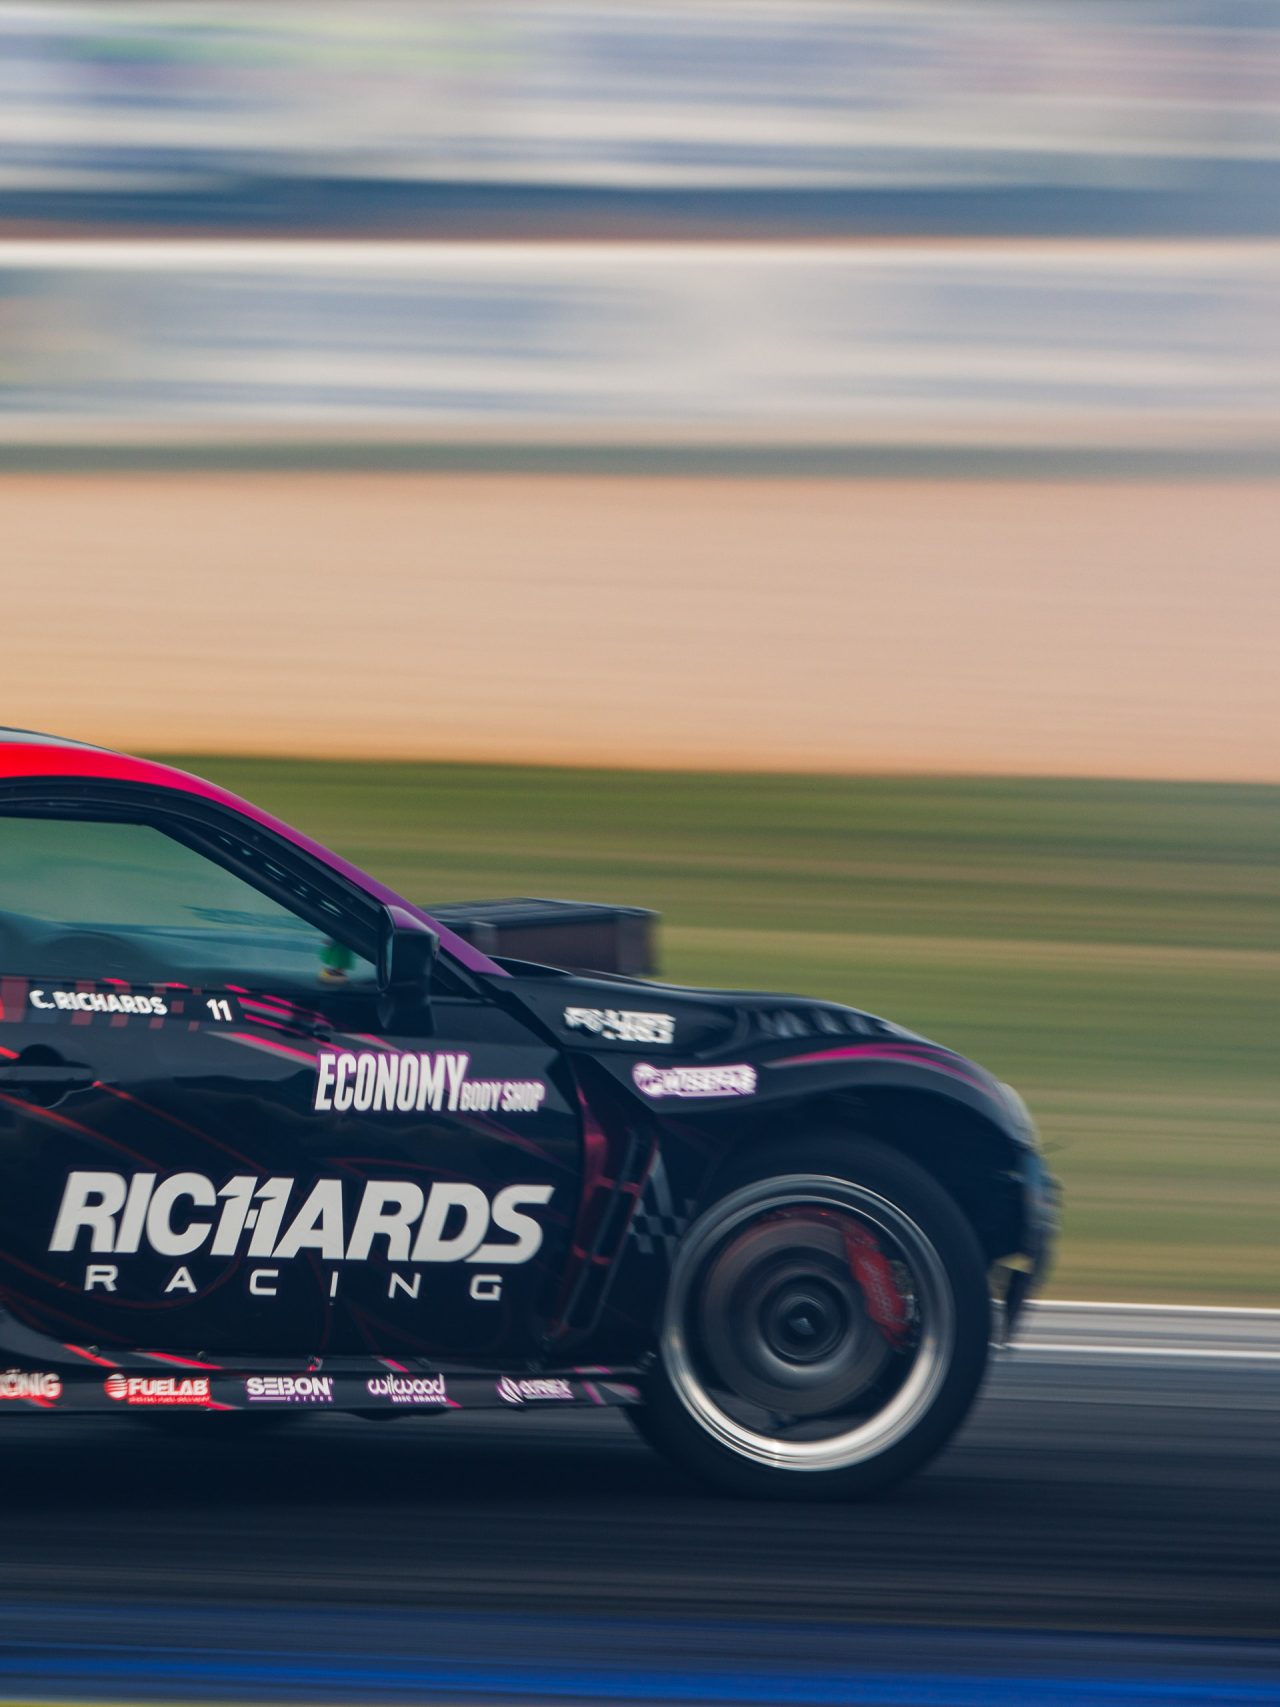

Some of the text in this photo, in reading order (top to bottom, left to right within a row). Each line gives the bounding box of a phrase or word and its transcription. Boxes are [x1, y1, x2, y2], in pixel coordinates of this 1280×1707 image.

[53, 992, 168, 1016] RICHARDS
[206, 999, 232, 1022] 11
[315, 1053, 468, 1112] ECONOMY
[84, 1264, 504, 1301] RACING
[127, 1377, 209, 1396] FUELAB
[246, 1377, 332, 1396] SEBON
[368, 1373, 446, 1396] wilwood
